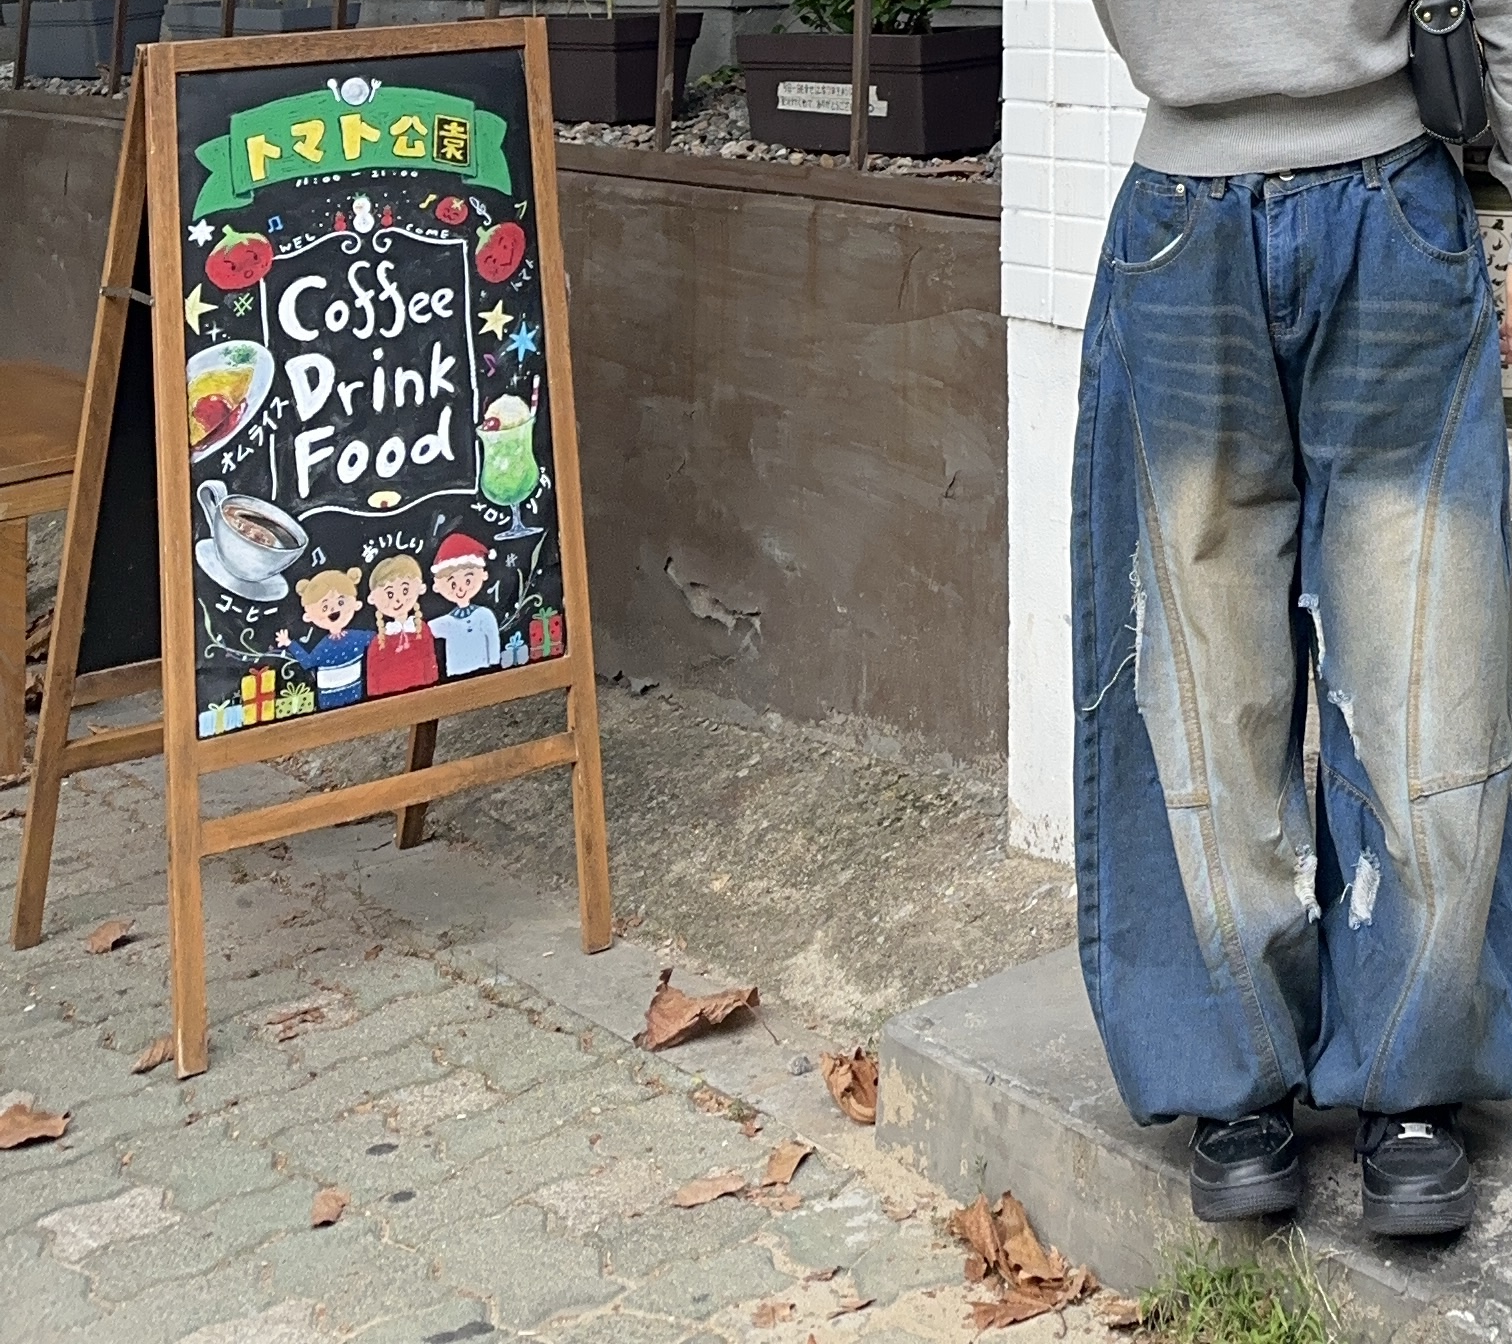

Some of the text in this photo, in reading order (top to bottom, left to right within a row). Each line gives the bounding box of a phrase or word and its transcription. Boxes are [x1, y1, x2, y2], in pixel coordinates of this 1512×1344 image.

[246, 113, 470, 182] トマト公園
[278, 260, 455, 342] Coffee
[284, 340, 456, 423] Drink
[220, 396, 291, 475] オムライス
[293, 404, 455, 500] Food
[470, 501, 511, 526] メロン
[525, 465, 552, 515] ソーダ
[361, 530, 425, 564] おいしい
[214, 593, 279, 623] コーヒー
